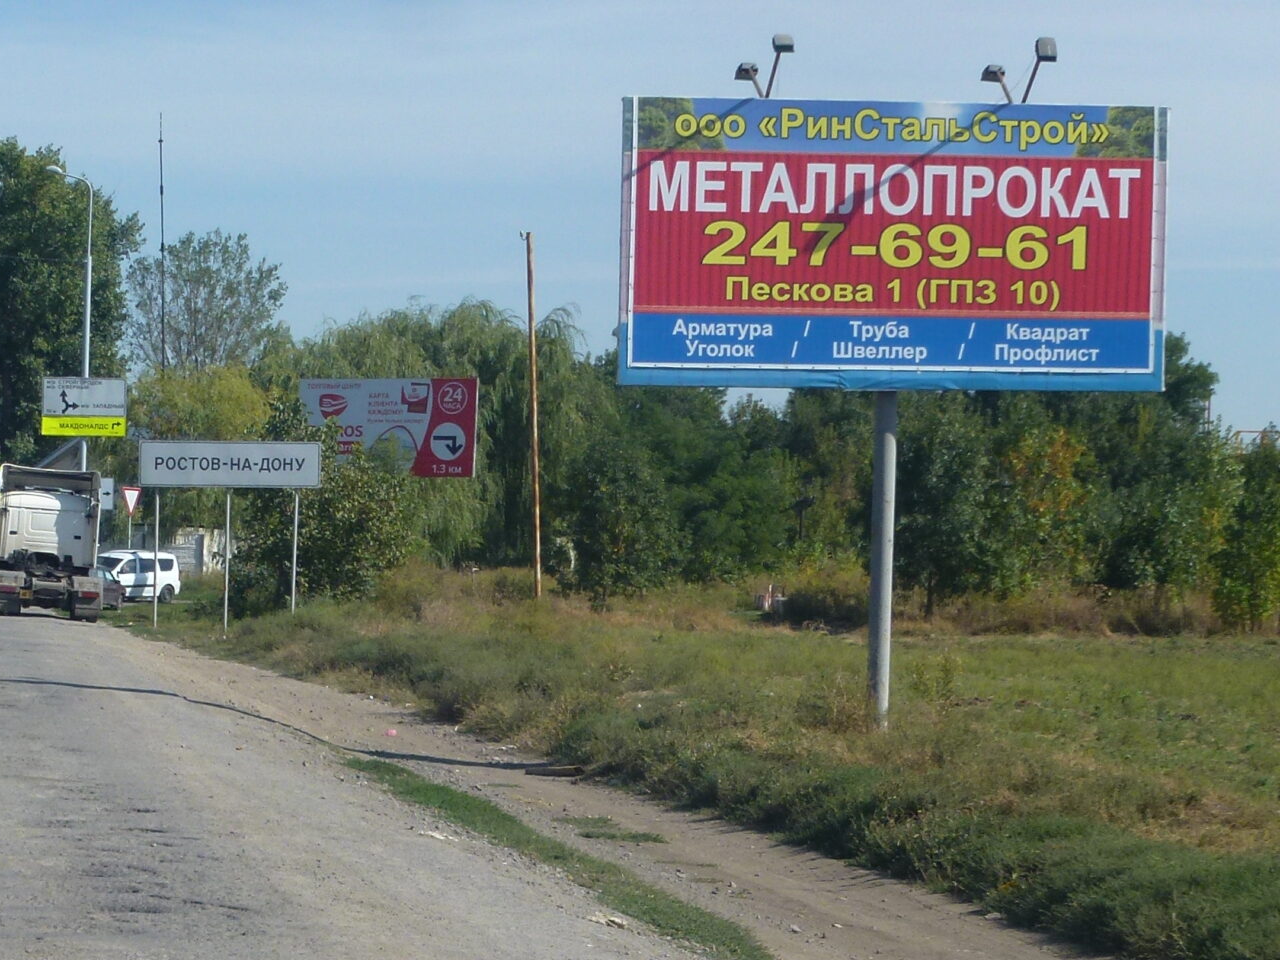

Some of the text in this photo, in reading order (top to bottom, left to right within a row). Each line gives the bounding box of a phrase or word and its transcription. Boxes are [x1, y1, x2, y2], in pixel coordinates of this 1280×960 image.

[758, 107, 1111, 150] «РинСтальСтрой»
[648, 160, 1142, 219] МЕТАЛЛОПРОКАТ
[701, 220, 1088, 271] 247-69-61
[725, 276, 1061, 312] Пескова 1 (ГПЗ 10)
[672, 318, 773, 343] Арматура
[849, 321, 910, 342] Труба
[1006, 323, 1090, 344] Квадрат
[685, 340, 755, 357] Уголок
[832, 342, 928, 363] Швеллер
[994, 344, 1100, 365] Профлист
[443, 387, 463, 402] 24
[154, 456, 306, 473] РОСТОВ-НА-ДОНУ
[431, 463, 447, 474] 1.3
